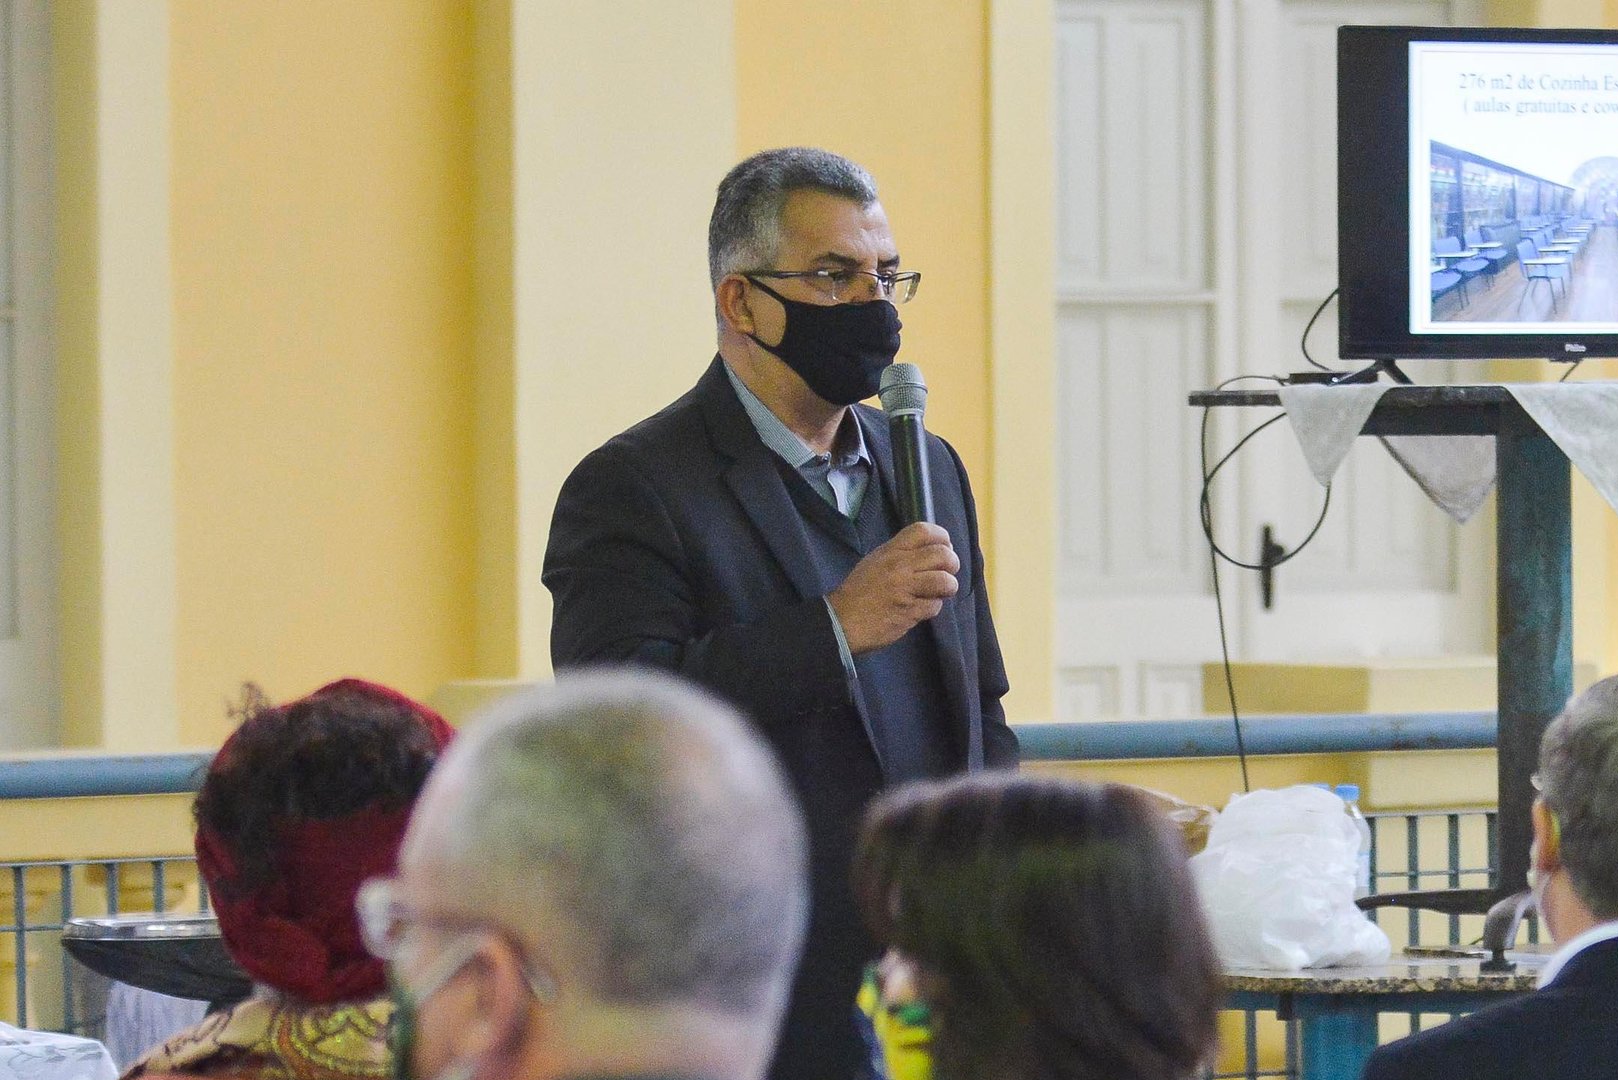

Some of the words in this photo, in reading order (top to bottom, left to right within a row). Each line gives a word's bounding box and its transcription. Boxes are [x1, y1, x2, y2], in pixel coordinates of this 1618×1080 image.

[1459, 73, 1486, 90] 276
[1490, 74, 1512, 90] m2
[1518, 75, 1534, 90] de
[1539, 75, 1598, 91] Cozinha
[1474, 97, 1511, 113] aulas
[1515, 99, 1577, 116] gratuitas
